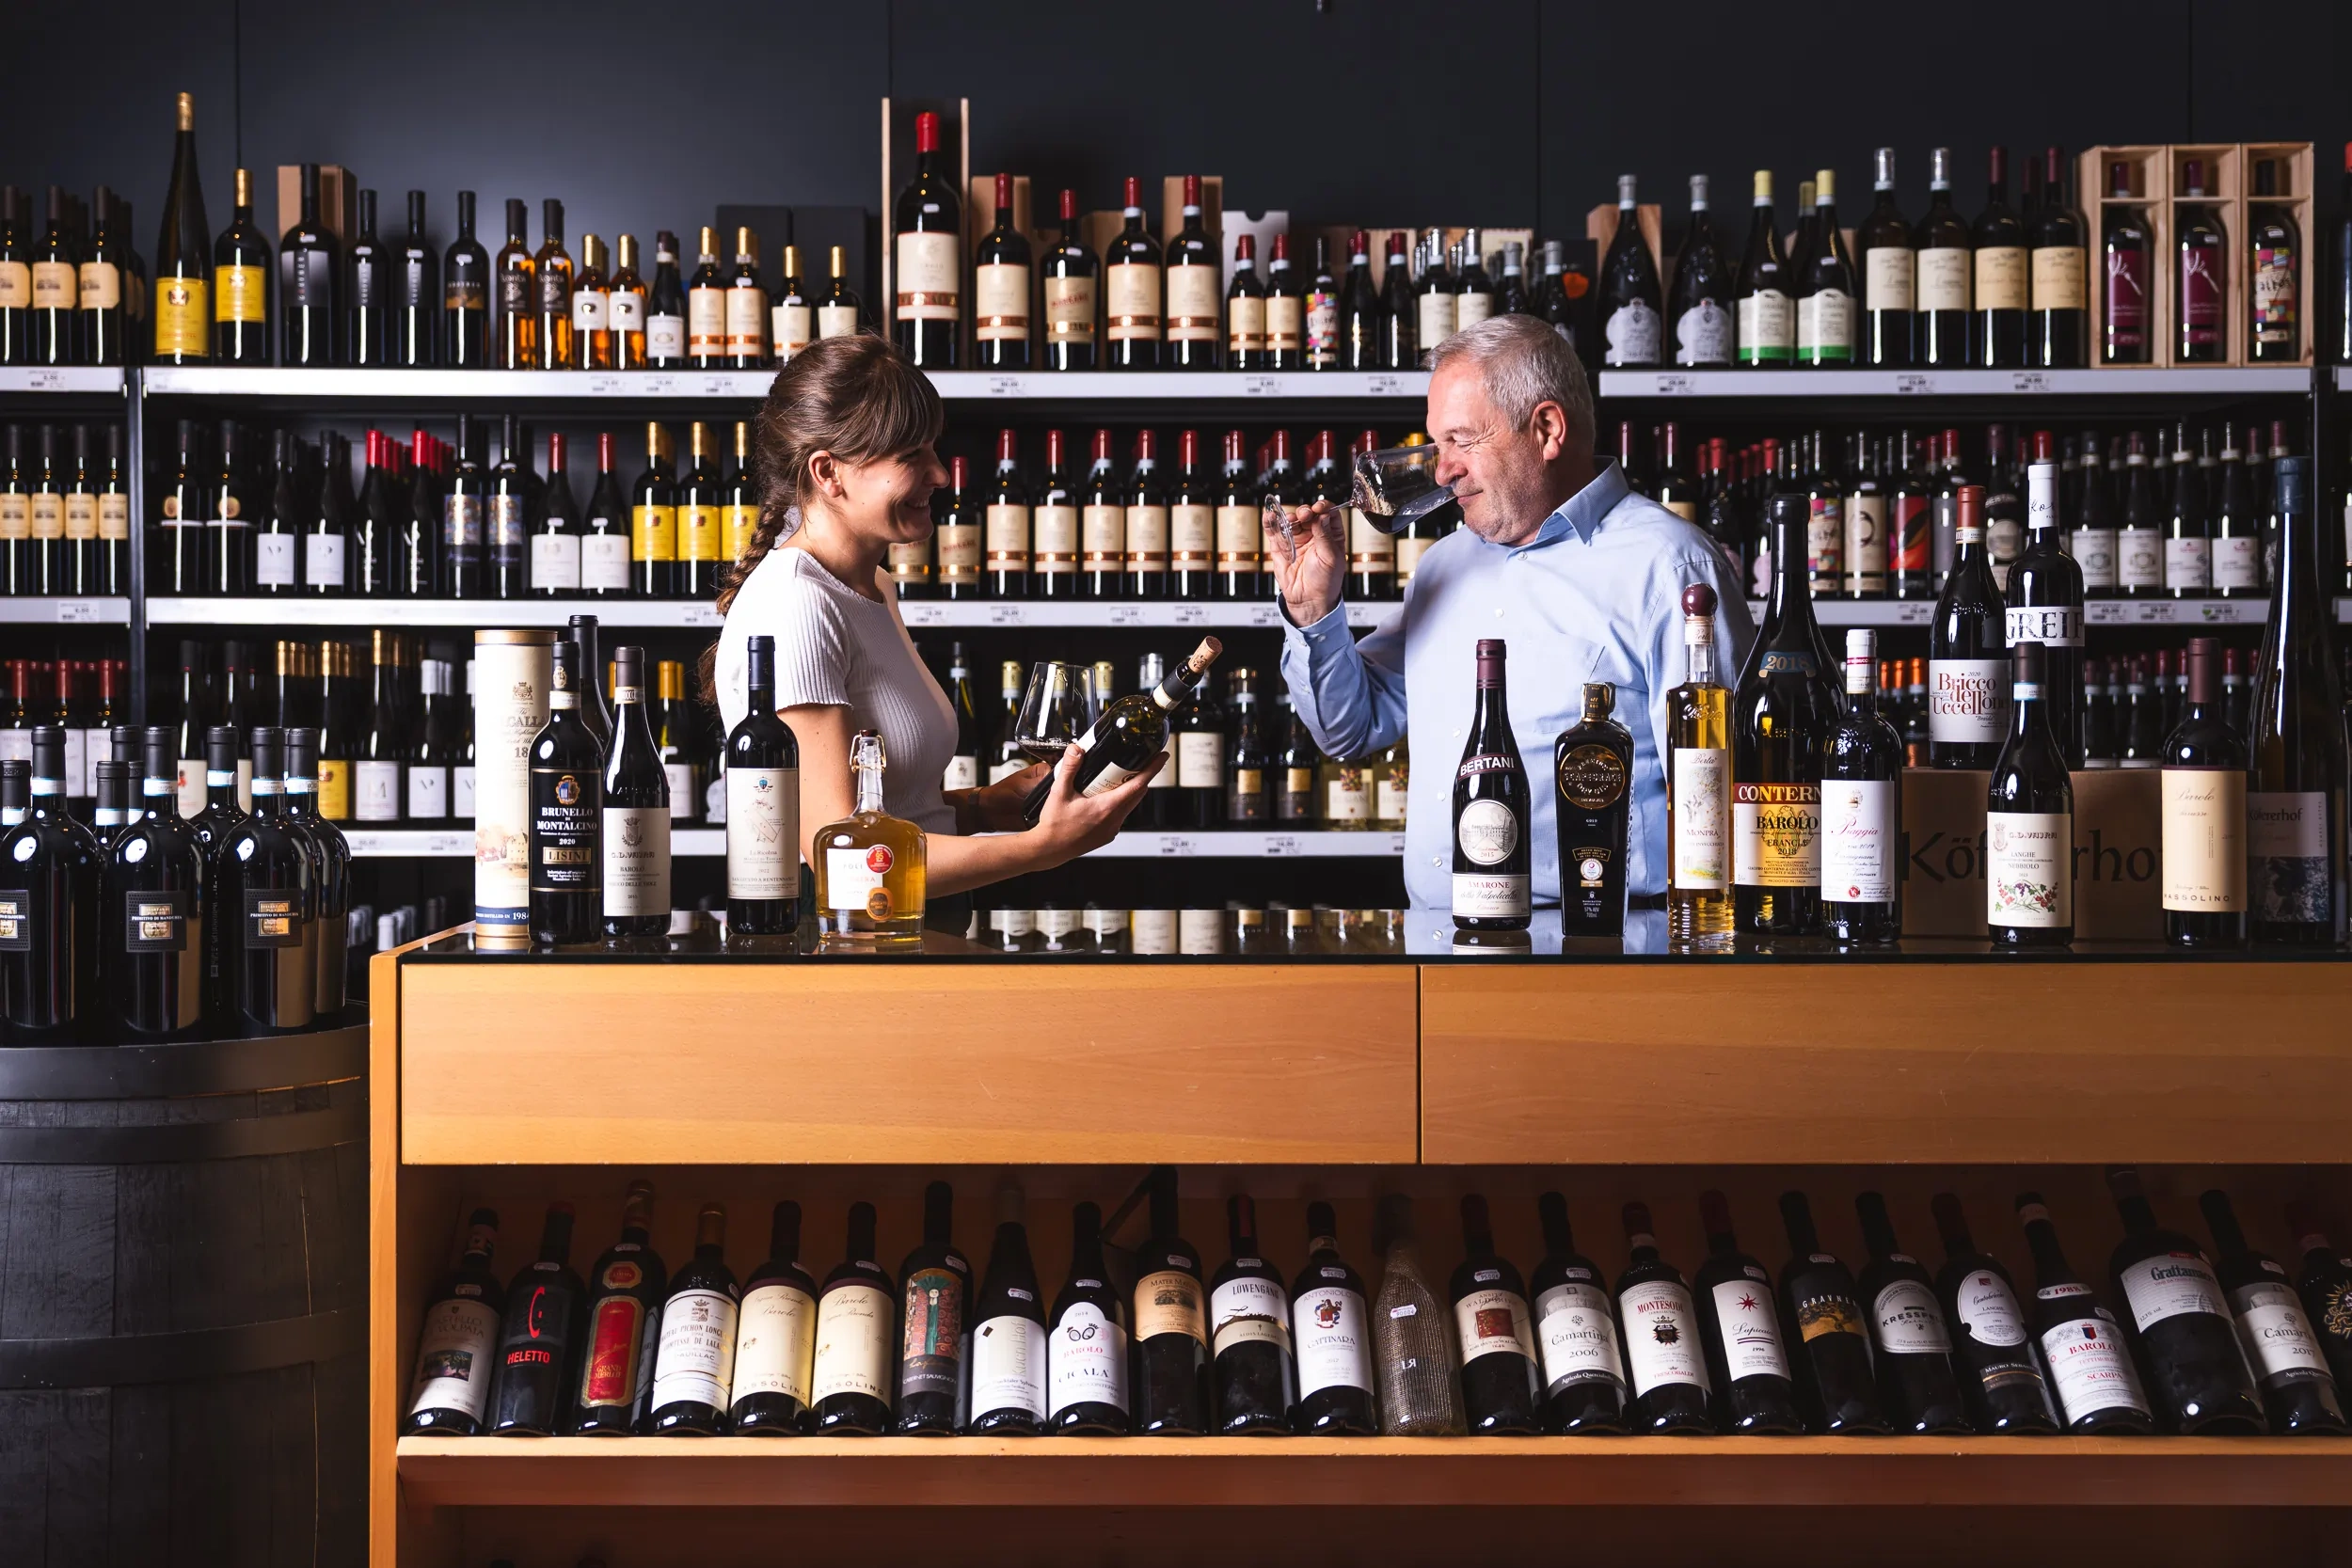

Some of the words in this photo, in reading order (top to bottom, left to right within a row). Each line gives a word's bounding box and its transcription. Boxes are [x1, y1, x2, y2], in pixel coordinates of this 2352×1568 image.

[1765, 656, 1809, 670] 2018
[1938, 673, 1996, 690] Bricco
[515, 747, 529, 758] 18
[1460, 756, 1515, 777] BERTANI
[541, 807, 593, 816] BRUNELLO
[536, 821, 597, 831] MONTALCINO
[1756, 816, 1819, 830] BAROLO
[548, 851, 587, 861] LISINI
[1469, 880, 1510, 889] AMARONE
[2054, 1286, 2081, 1295] 1988
[1637, 1300, 1684, 1314] MONTESODI
[680, 1324, 703, 1333] PICHON
[1551, 1329, 1609, 1346] Camartina
[1064, 1347, 1103, 1358] BAROLO
[1568, 1348, 1598, 1358] 2006
[2069, 1341, 2117, 1354] BAROLO
[507, 1350, 551, 1364] HELETTO
[1561, 1373, 1582, 1385] Agricola
[2087, 1372, 2123, 1381] SCARPA
[813, 1380, 884, 1399] ASSOLINO
